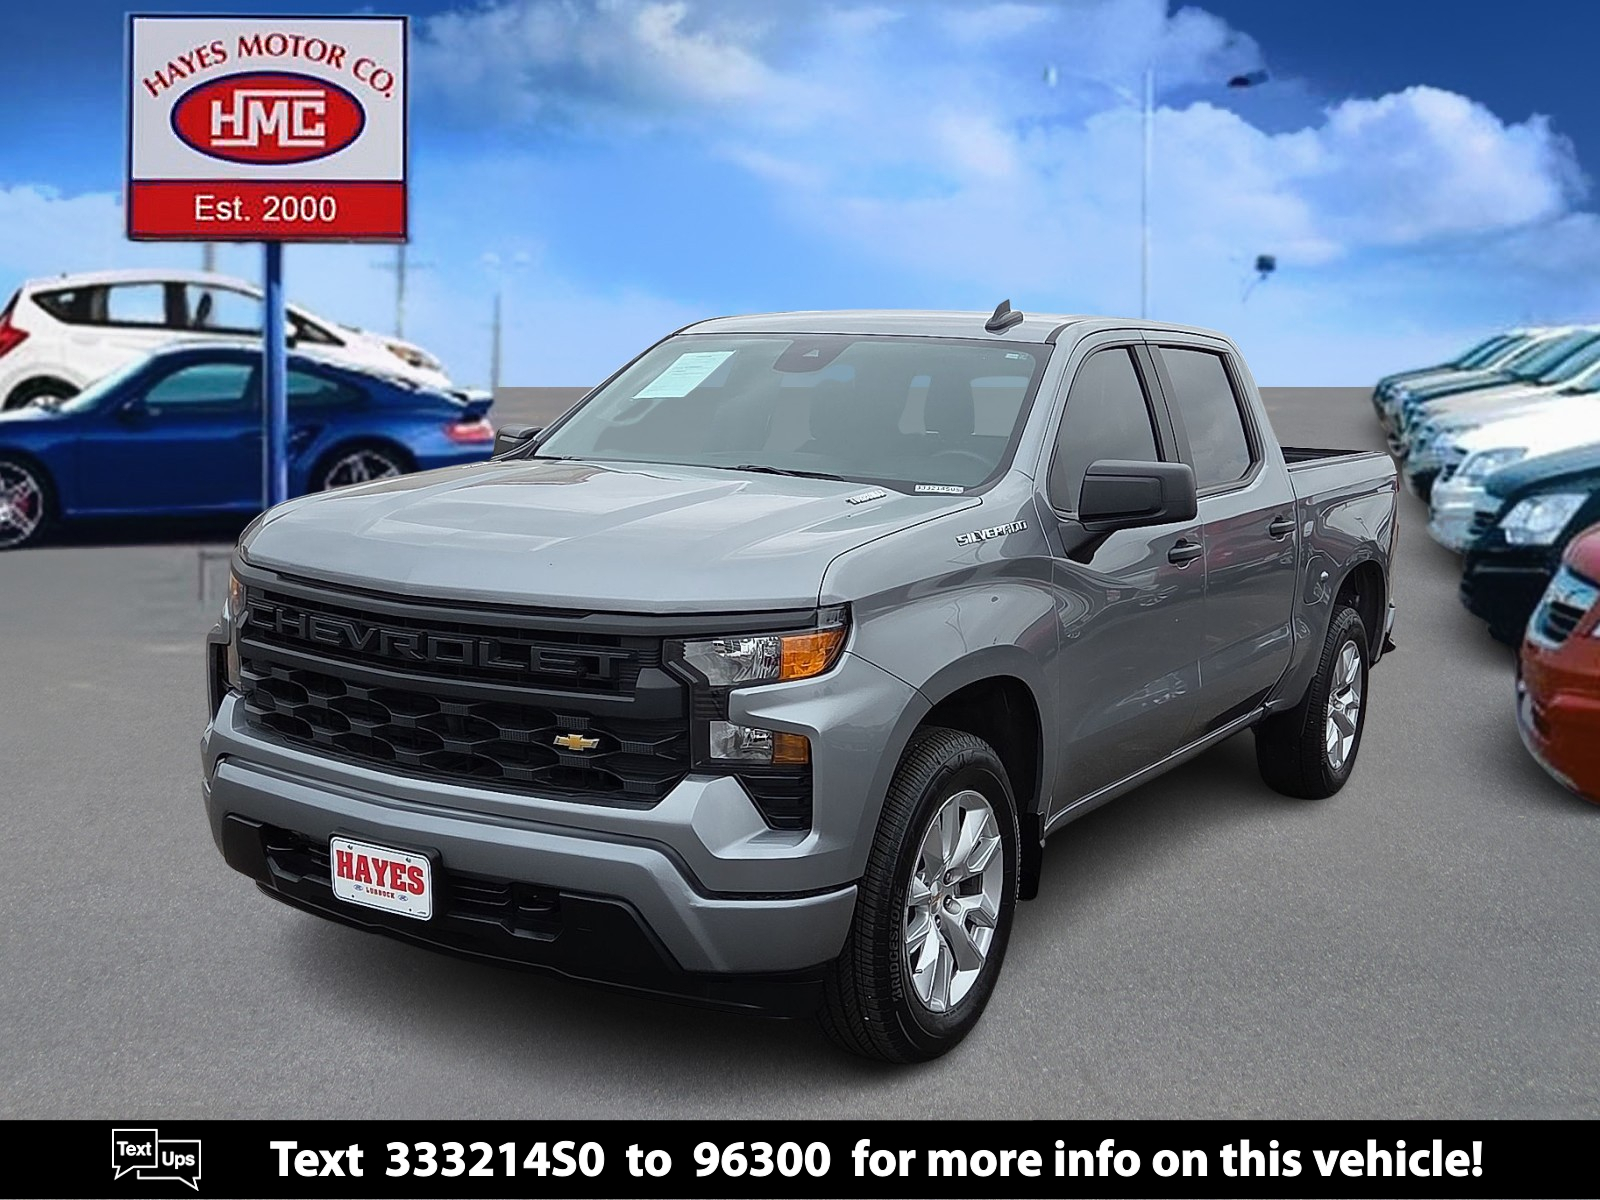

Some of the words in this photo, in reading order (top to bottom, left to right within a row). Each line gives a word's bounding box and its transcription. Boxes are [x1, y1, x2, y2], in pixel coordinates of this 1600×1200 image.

[143, 40, 228, 98] HAYES
[237, 33, 347, 70] MOTOR
[352, 57, 395, 99] CO.
[210, 88, 326, 147] HMC
[194, 194, 250, 222] Est.
[262, 195, 337, 222] 2000
[955, 519, 1029, 547] SILVERADO
[247, 600, 635, 679] CHEVROLET
[336, 849, 425, 896] HAYES
